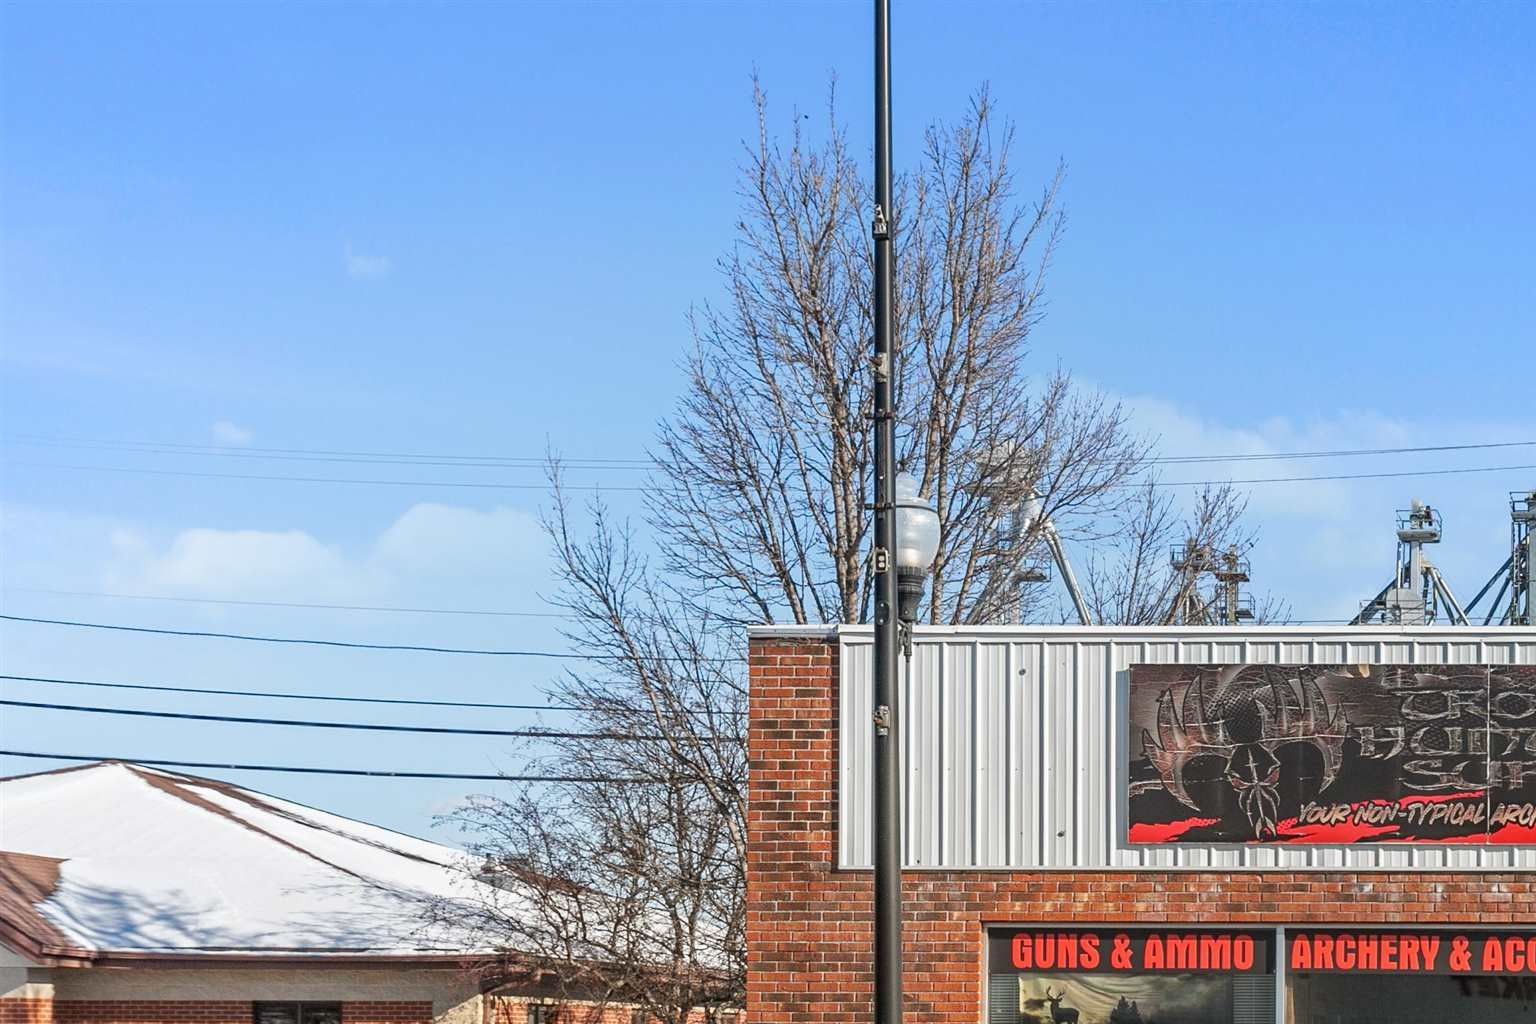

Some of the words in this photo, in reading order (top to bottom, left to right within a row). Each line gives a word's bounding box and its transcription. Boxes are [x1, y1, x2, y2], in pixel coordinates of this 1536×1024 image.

[1298, 800, 1349, 826] YOUR
[1352, 801, 1485, 827] NON-TYPICAL
[1011, 933, 1100, 969] GUNS
[1111, 934, 1133, 969] &
[1144, 934, 1255, 970] AMMO
[1291, 934, 1440, 970] ARCHERY
[1449, 936, 1472, 971] &
